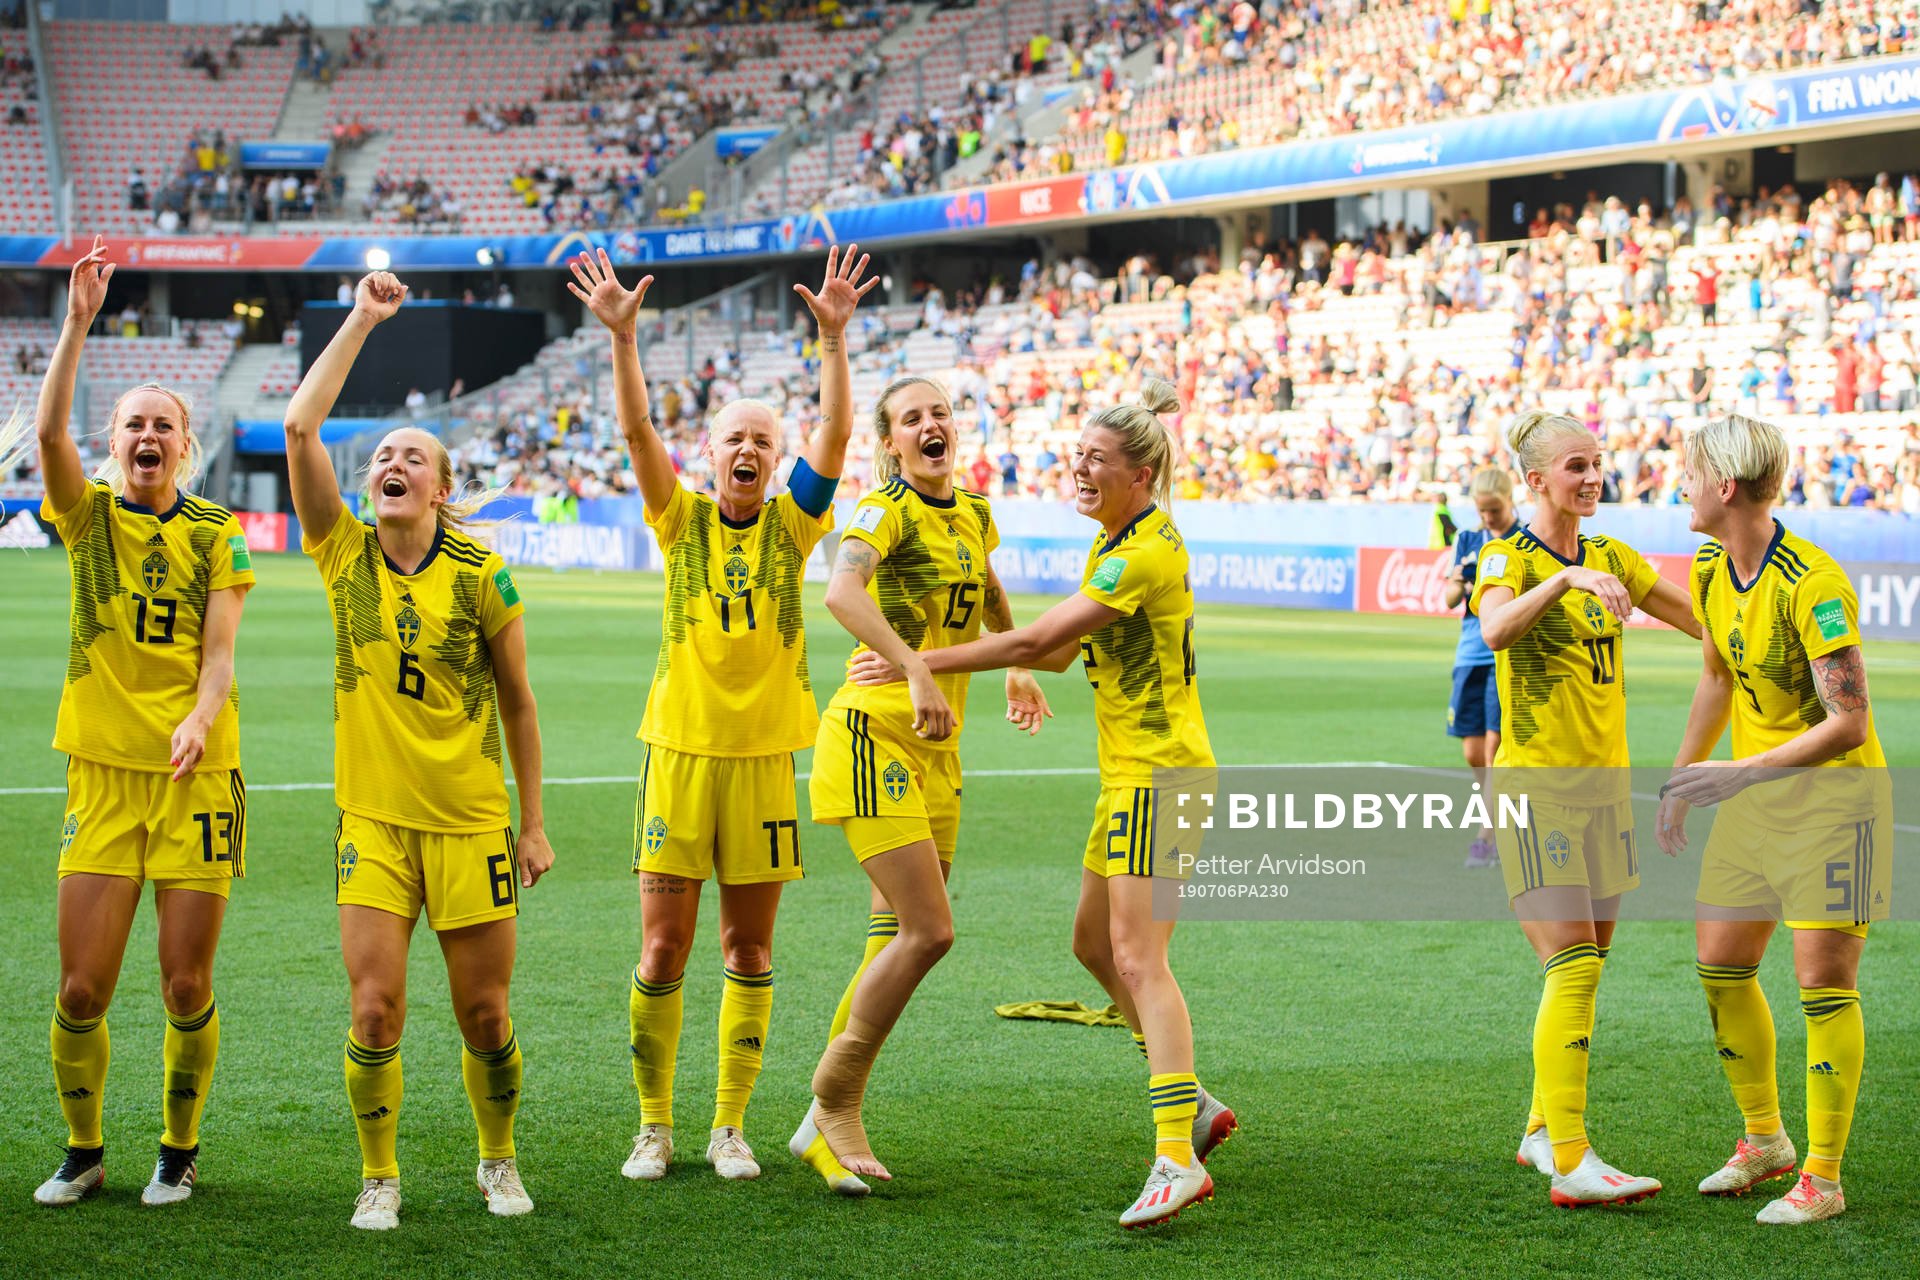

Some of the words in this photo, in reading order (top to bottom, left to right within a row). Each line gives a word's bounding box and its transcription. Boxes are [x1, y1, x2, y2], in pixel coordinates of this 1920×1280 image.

[1808, 77, 1857, 114] FIFA
[1219, 554, 1297, 593] FRANCE
[1299, 556, 1346, 595] 2019
[131, 592, 176, 643] 13
[942, 582, 979, 630] 15
[397, 650, 425, 700] 6
[1582, 636, 1615, 684] 10
[193, 812, 234, 862] 13
[487, 853, 514, 907] 6
[1825, 862, 1851, 912] 5
